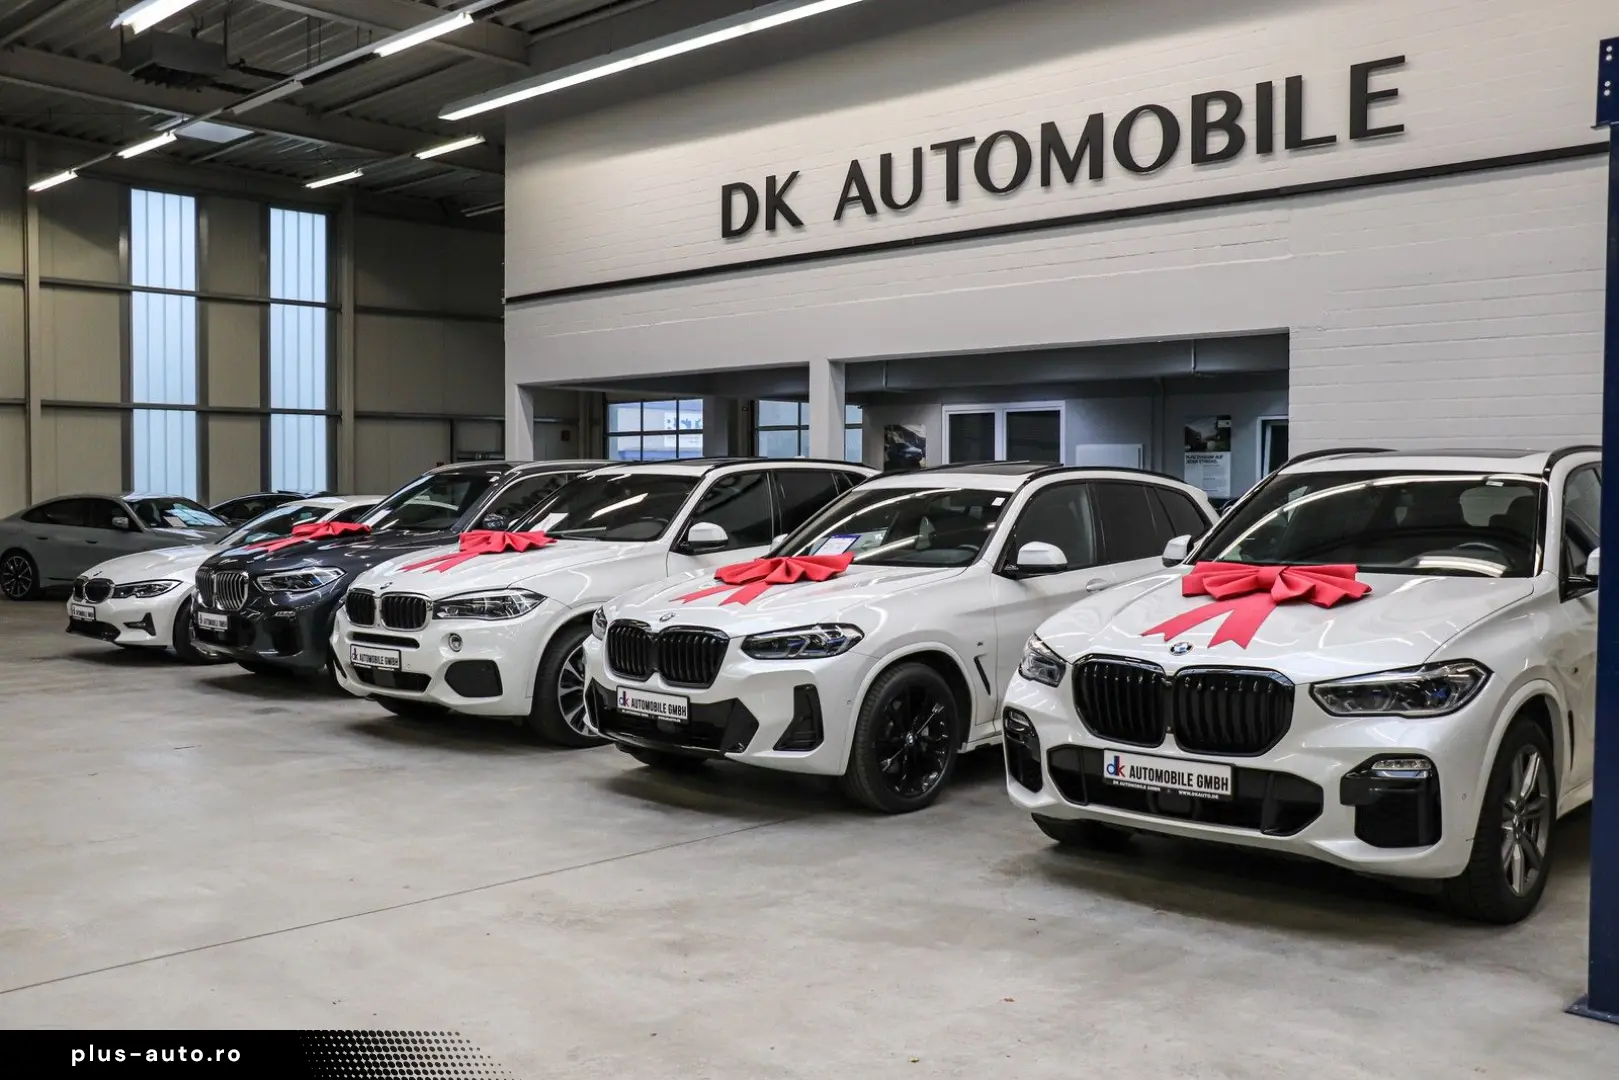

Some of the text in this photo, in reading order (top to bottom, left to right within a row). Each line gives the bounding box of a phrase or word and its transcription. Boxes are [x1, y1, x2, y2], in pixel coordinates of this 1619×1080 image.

[721, 55, 1406, 239] DK AUTOMOBILE
[631, 697, 667, 714] AUTOMOBILE
[668, 703, 687, 717] GMBH
[1106, 755, 1229, 791] dk AUTOMOBILE GMBH
